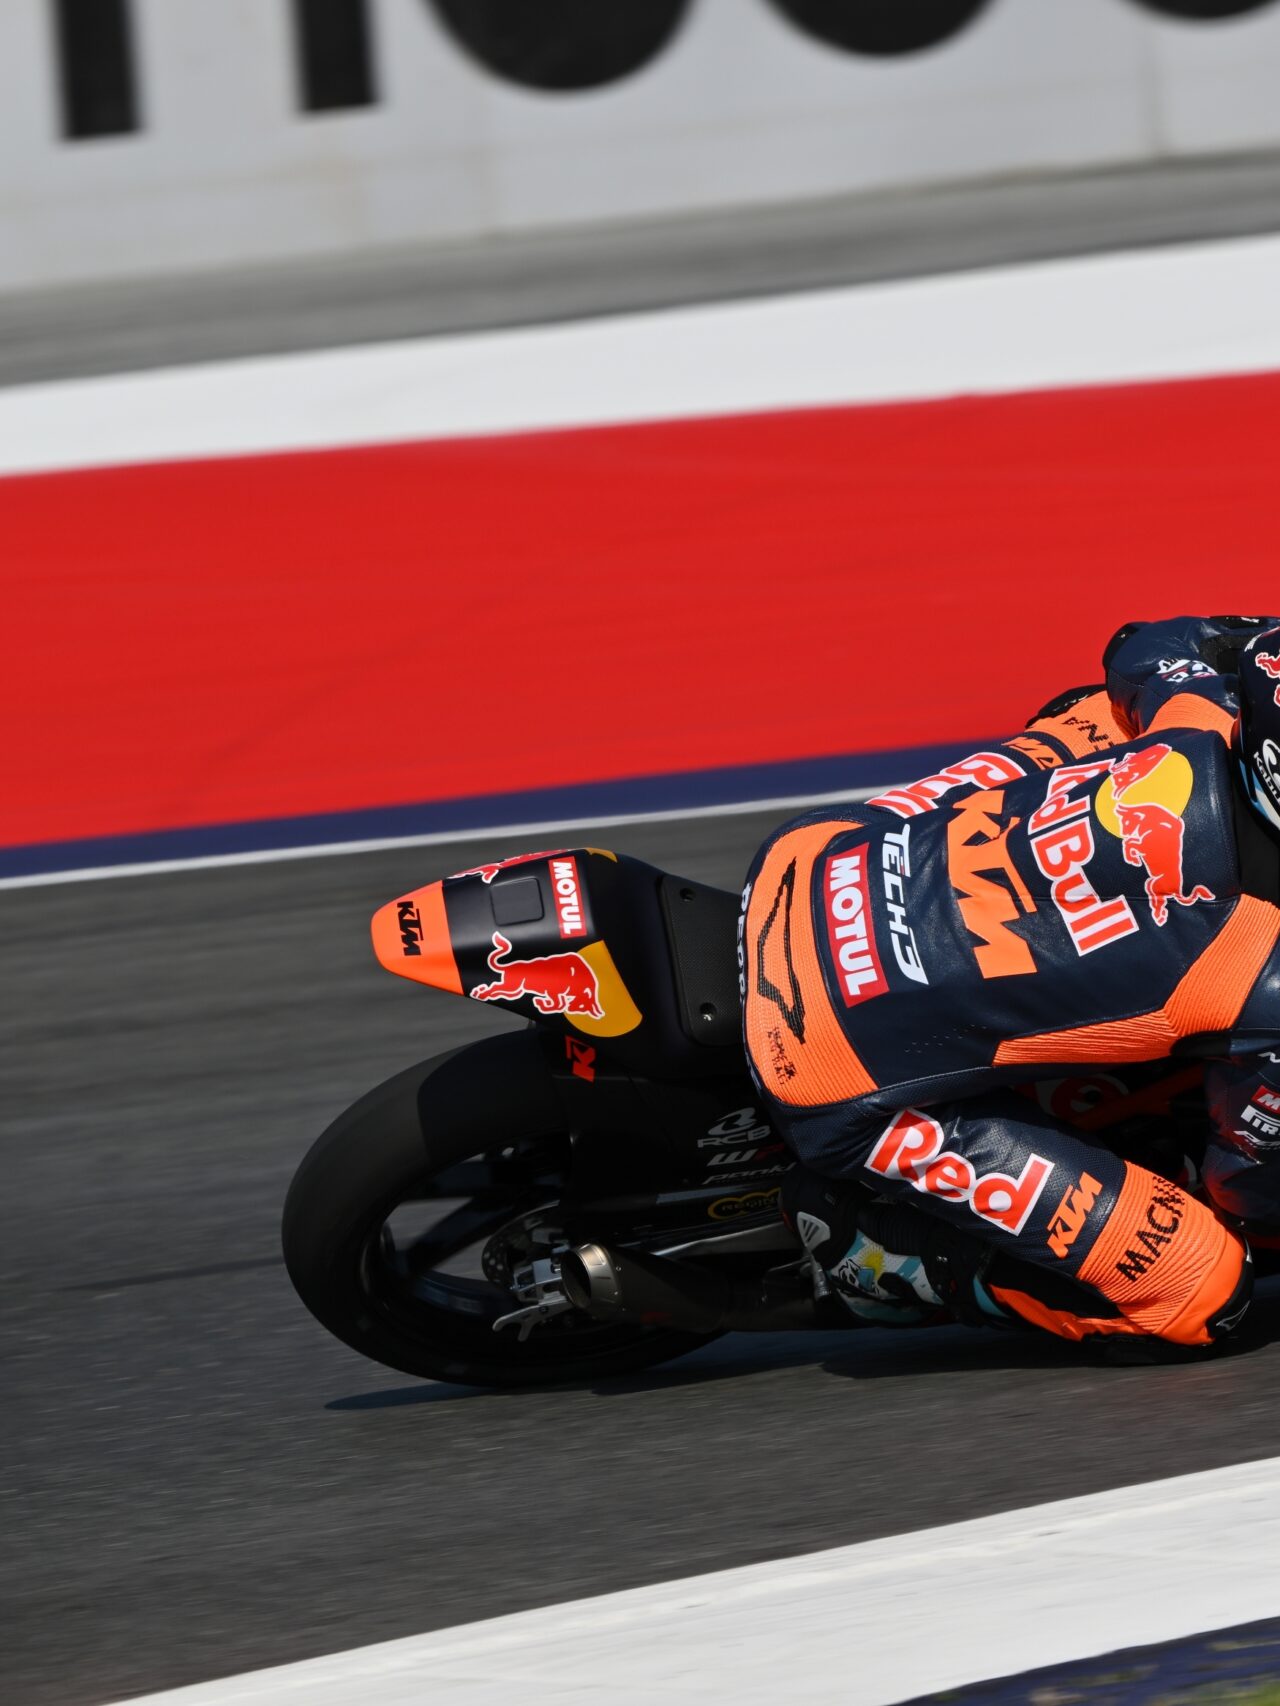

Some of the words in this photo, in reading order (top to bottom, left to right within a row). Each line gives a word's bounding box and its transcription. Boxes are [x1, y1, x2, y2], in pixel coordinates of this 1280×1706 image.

[864, 752, 1028, 819] Bull
[1028, 758, 1116, 836] Rd
[397, 900, 424, 957] KTM
[552, 861, 582, 935] MOTUL
[830, 853, 878, 996] MOTUL
[881, 823, 929, 985] TECH3
[946, 789, 1038, 979] KTM
[1030, 816, 1140, 957] Bull
[863, 1107, 1055, 1237] Red
[1046, 1170, 1104, 1259] KTM
